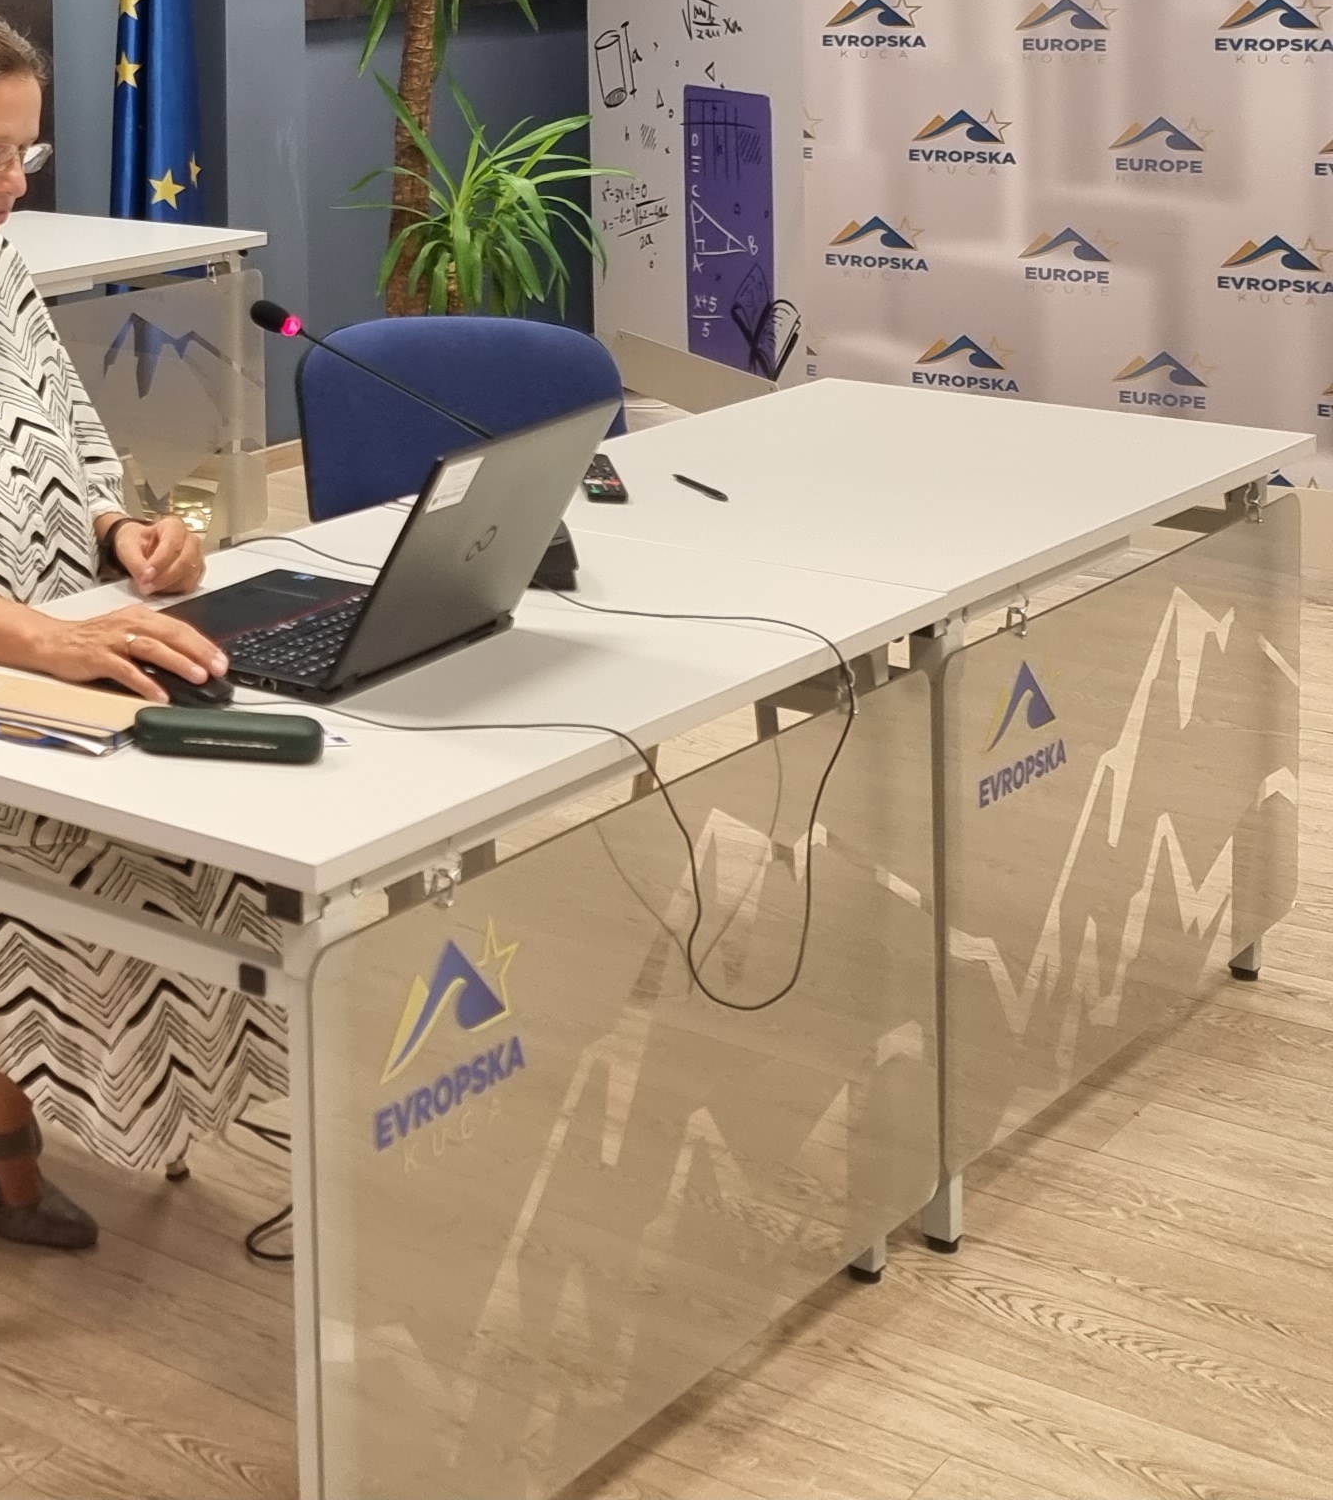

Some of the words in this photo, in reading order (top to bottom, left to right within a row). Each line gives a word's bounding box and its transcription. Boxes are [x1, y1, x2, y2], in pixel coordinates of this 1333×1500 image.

[909, 149, 1016, 164] EVROPSKA
[1116, 158, 1202, 173] EUROPE
[979, 739, 1066, 809] EVROPSKA
[372, 1036, 526, 1152] EVROPSKA
